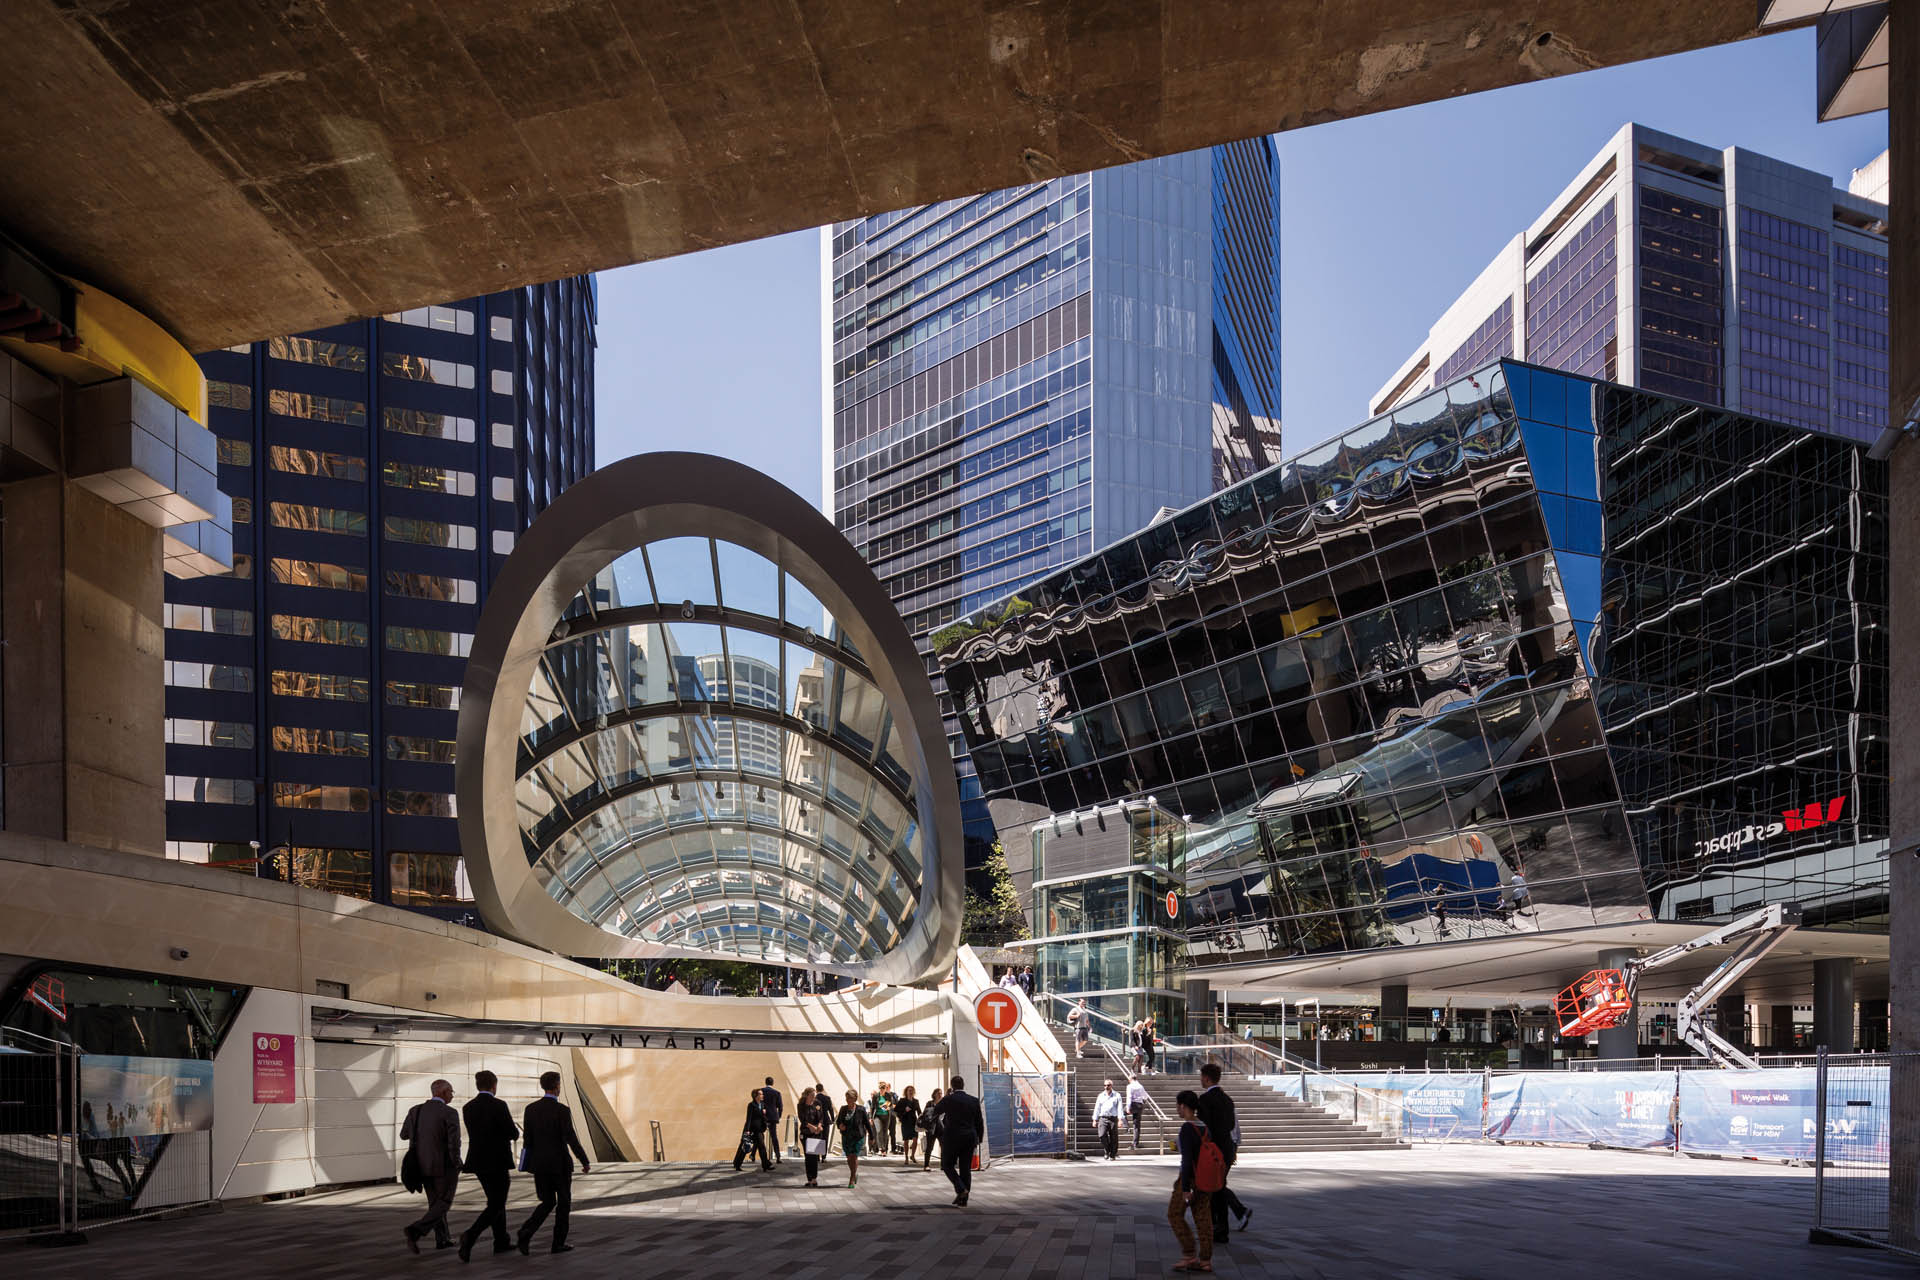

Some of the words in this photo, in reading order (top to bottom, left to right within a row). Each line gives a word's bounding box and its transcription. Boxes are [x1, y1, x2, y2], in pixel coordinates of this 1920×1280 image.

[987, 1001, 1008, 1029] T
[545, 1031, 732, 1050] WYNYARD
[1360, 1062, 1378, 1070] Sushi
[1741, 1094, 1771, 1103] Wynyard
[1772, 1093, 1789, 1102] Walk
[1016, 1109, 1057, 1123] SYDNEY
[1620, 1105, 1655, 1119] SYDNEY
